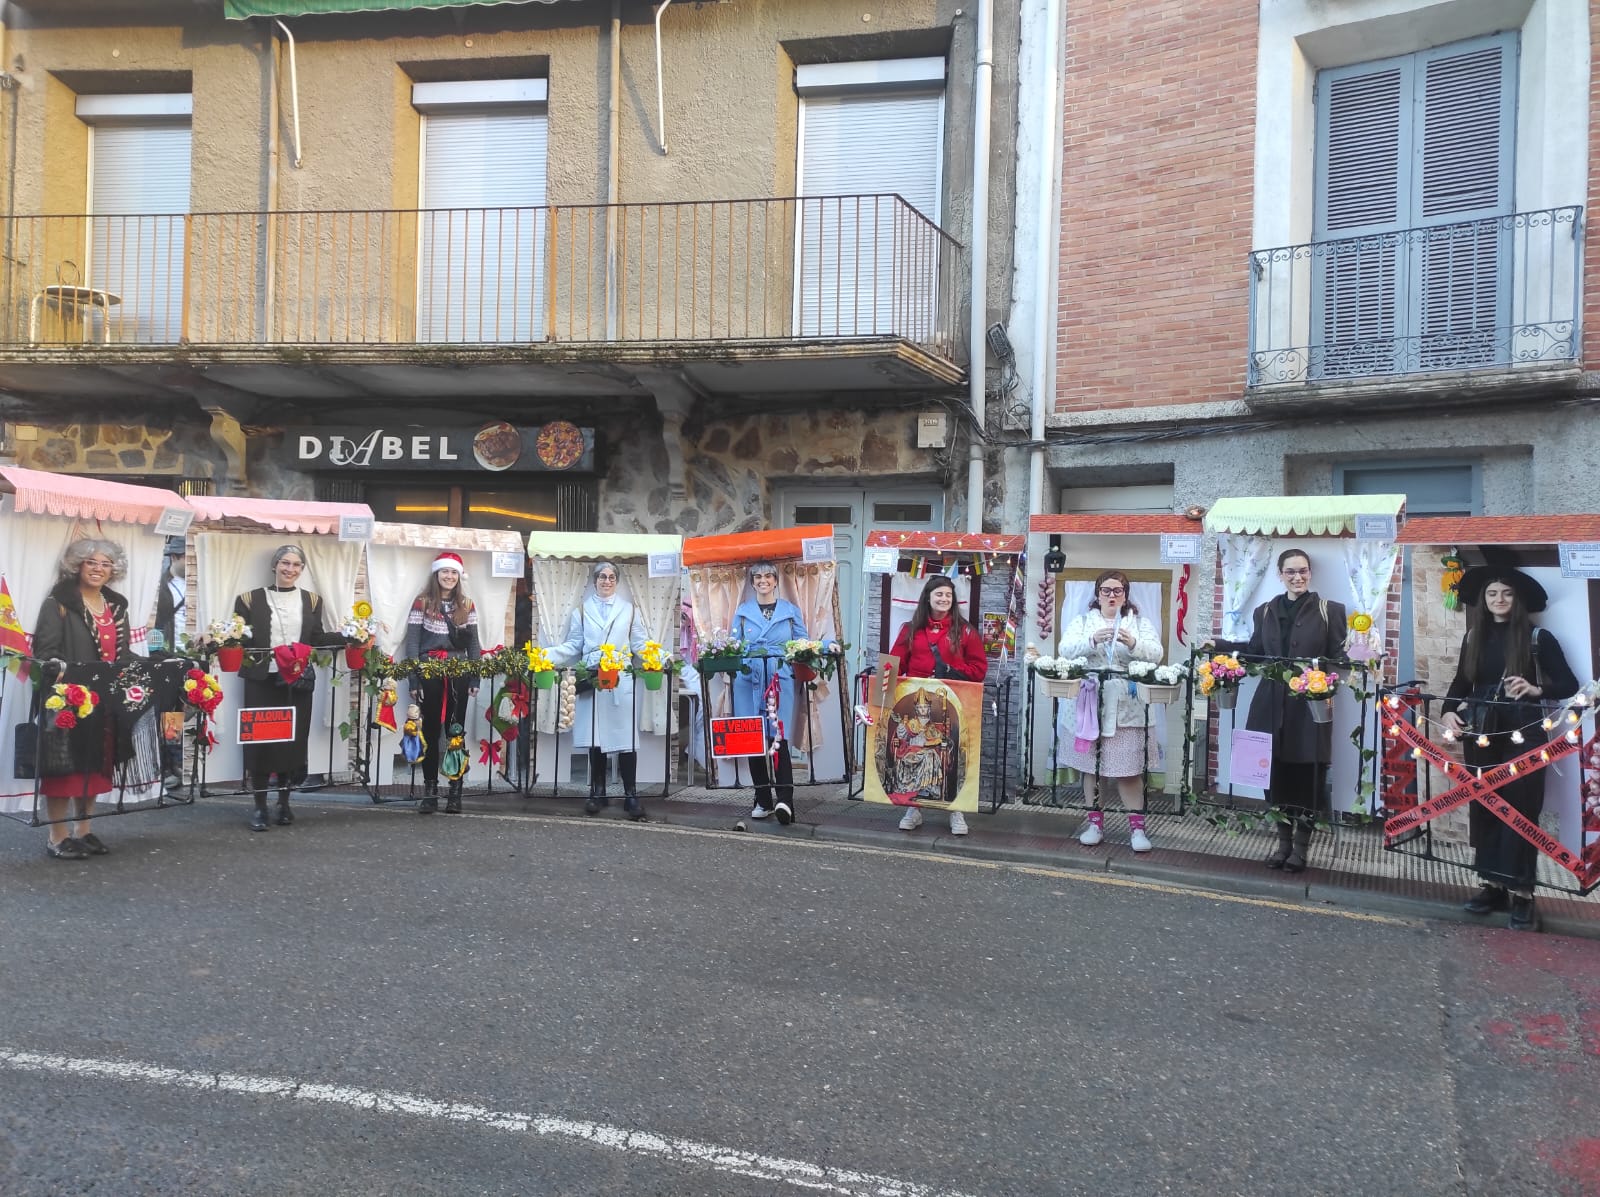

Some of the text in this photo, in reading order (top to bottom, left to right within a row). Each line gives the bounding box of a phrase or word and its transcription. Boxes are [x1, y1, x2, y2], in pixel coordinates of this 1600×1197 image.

[298, 429, 458, 466] DIABEL
[241, 710, 291, 723] SE ALQUILA
[713, 719, 762, 733] SE VENDE
[1406, 728, 1558, 854] WARNING! WARNING!
[1432, 786, 1472, 811] WARNING!
